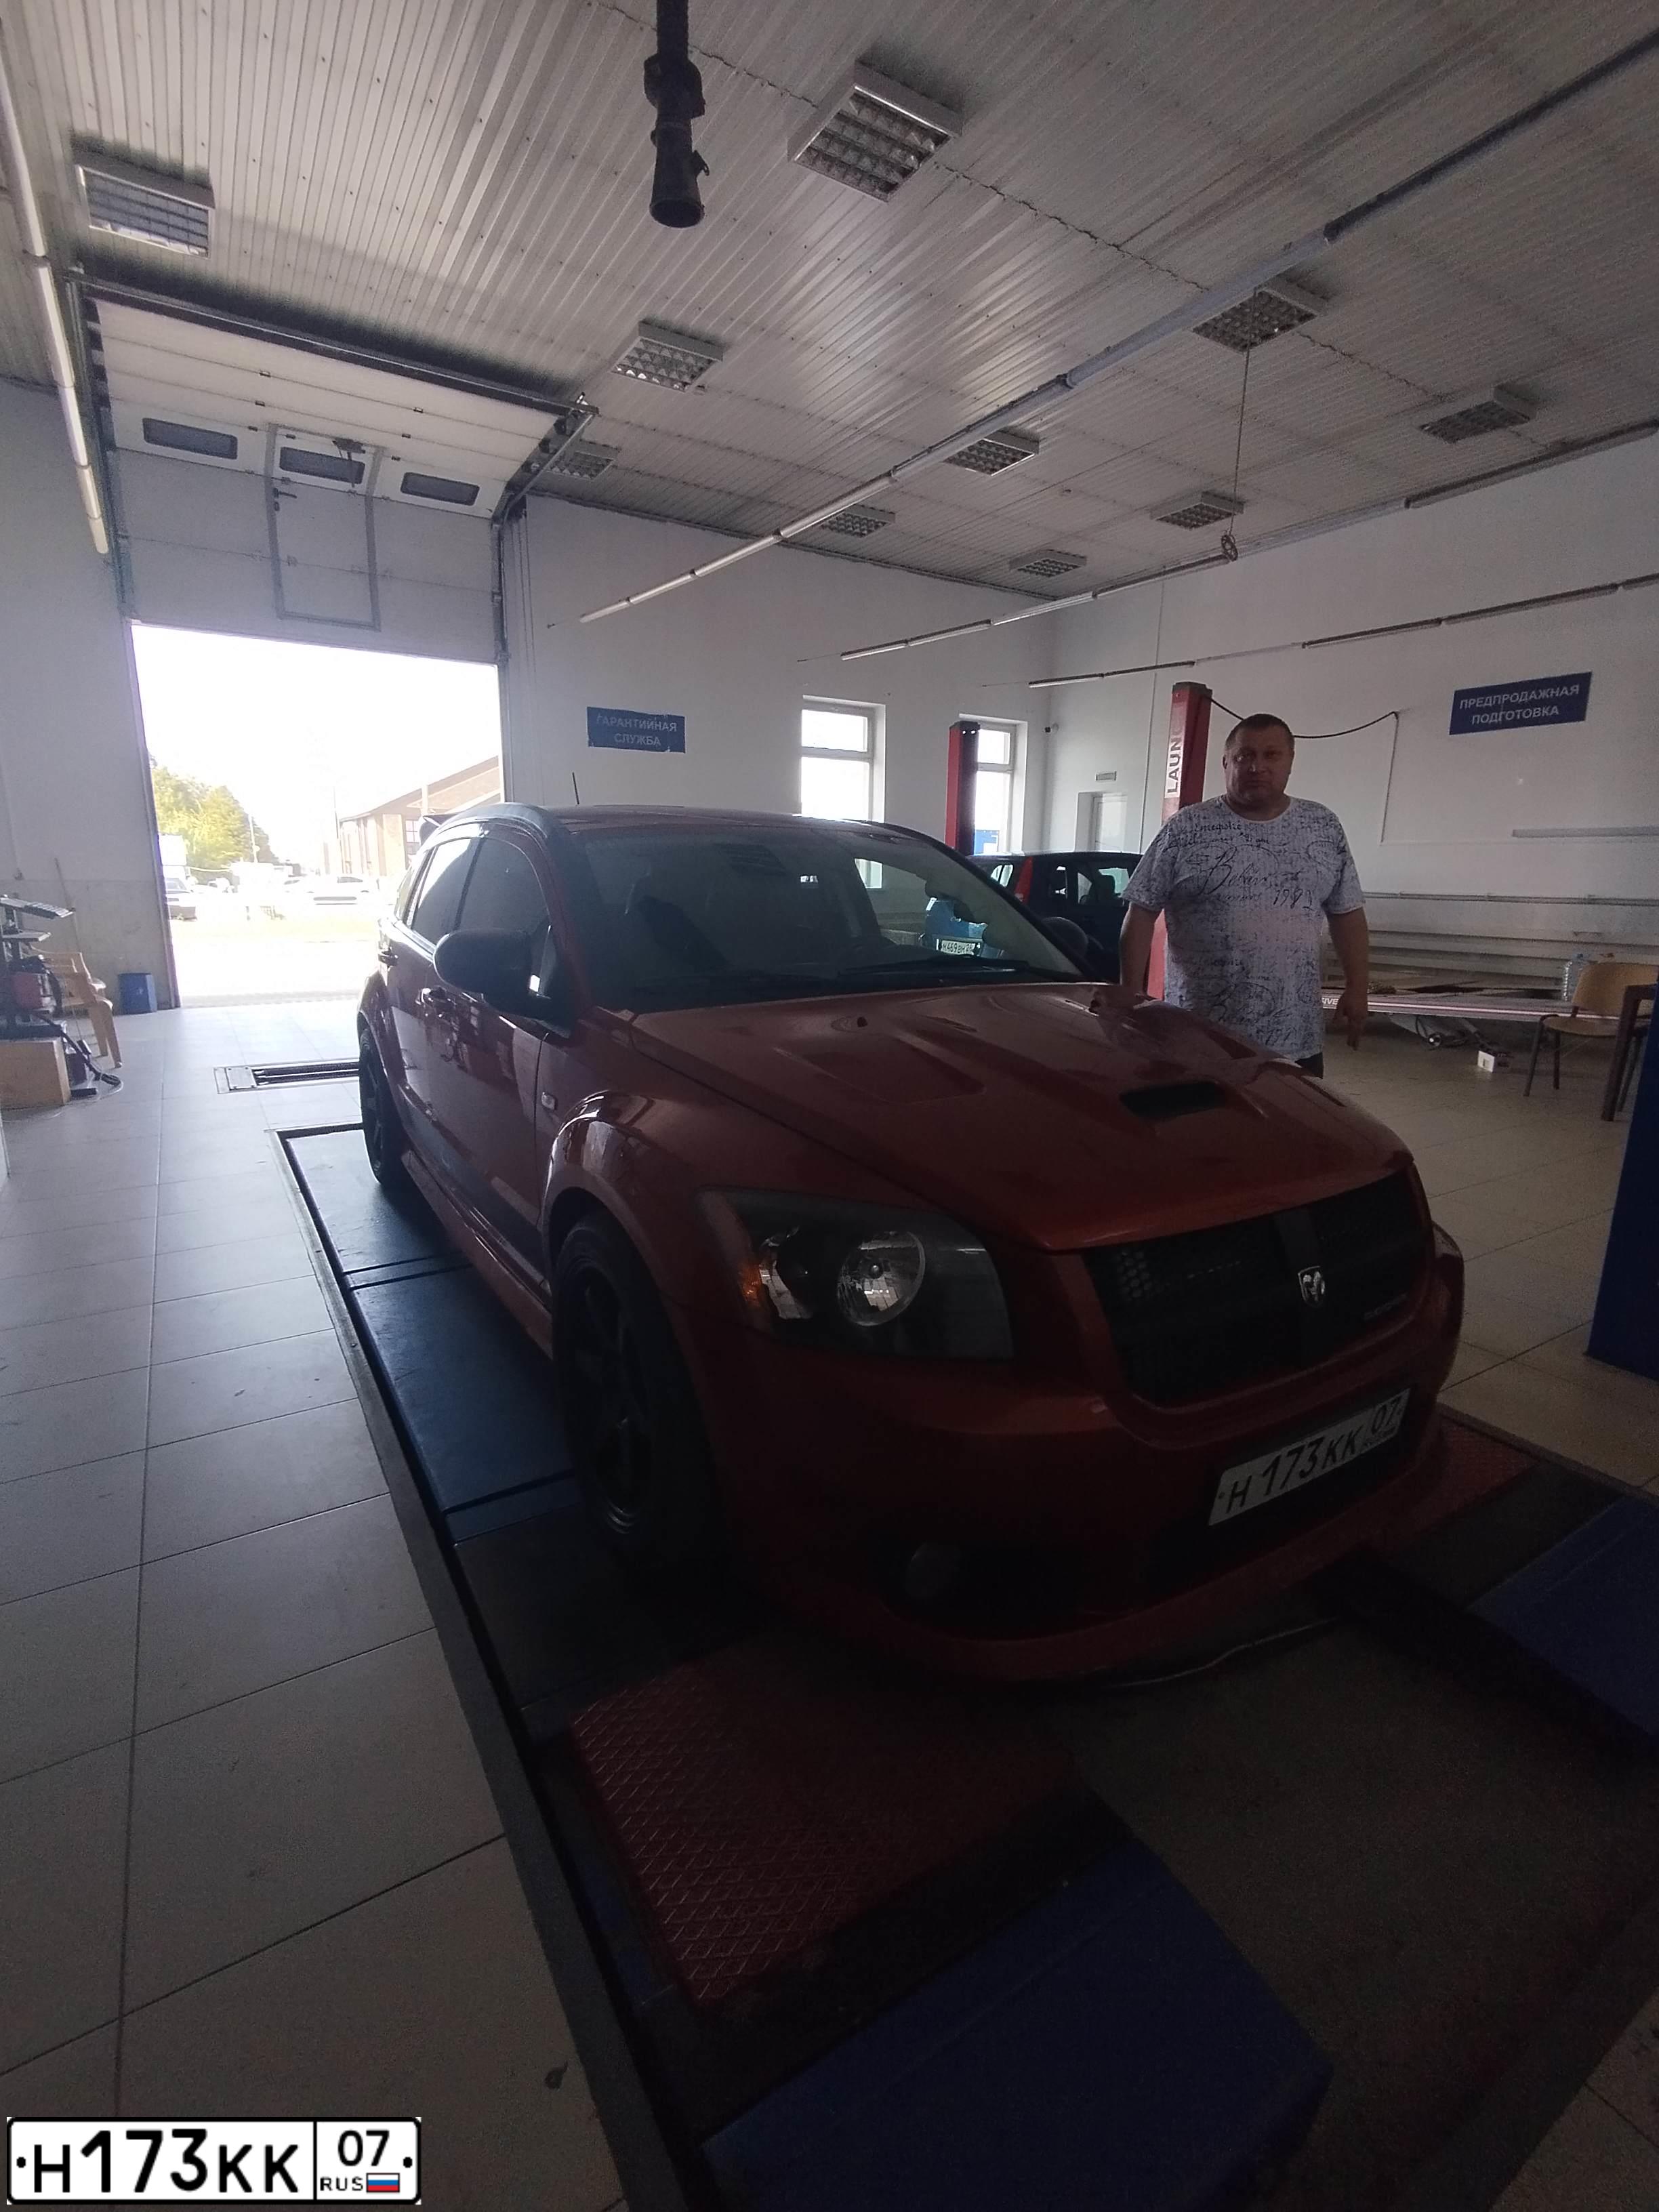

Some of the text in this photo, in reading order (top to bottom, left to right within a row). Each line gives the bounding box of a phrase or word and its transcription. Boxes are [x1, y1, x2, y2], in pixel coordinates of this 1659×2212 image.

[1460, 684, 1580, 709] ПРЕДПРОДАЖНАЯ
[1471, 705, 1559, 724] ПОДГОТОВКА
[613, 733, 662, 746] СЛУЖБА
